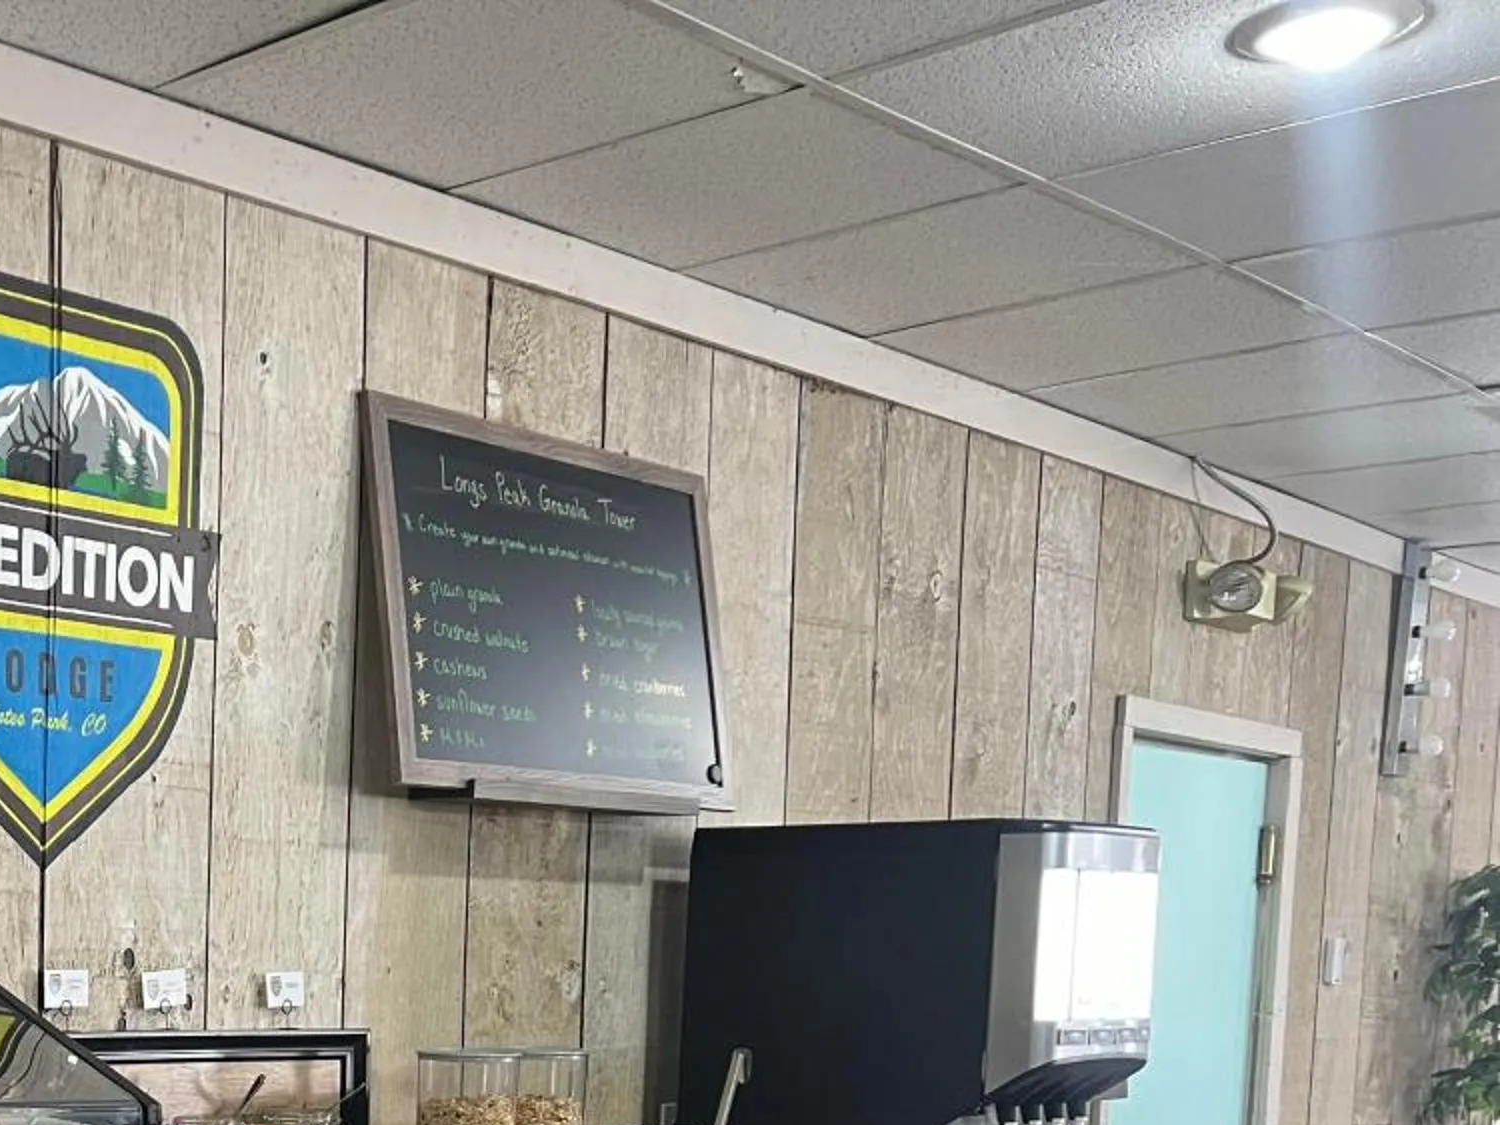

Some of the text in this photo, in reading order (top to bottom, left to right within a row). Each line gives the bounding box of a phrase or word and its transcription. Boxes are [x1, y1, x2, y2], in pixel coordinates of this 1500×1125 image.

[439, 454, 488, 509] Longs
[495, 471, 531, 507] Peak
[598, 499, 636, 530] Tower
[80, 713, 108, 737] CO
